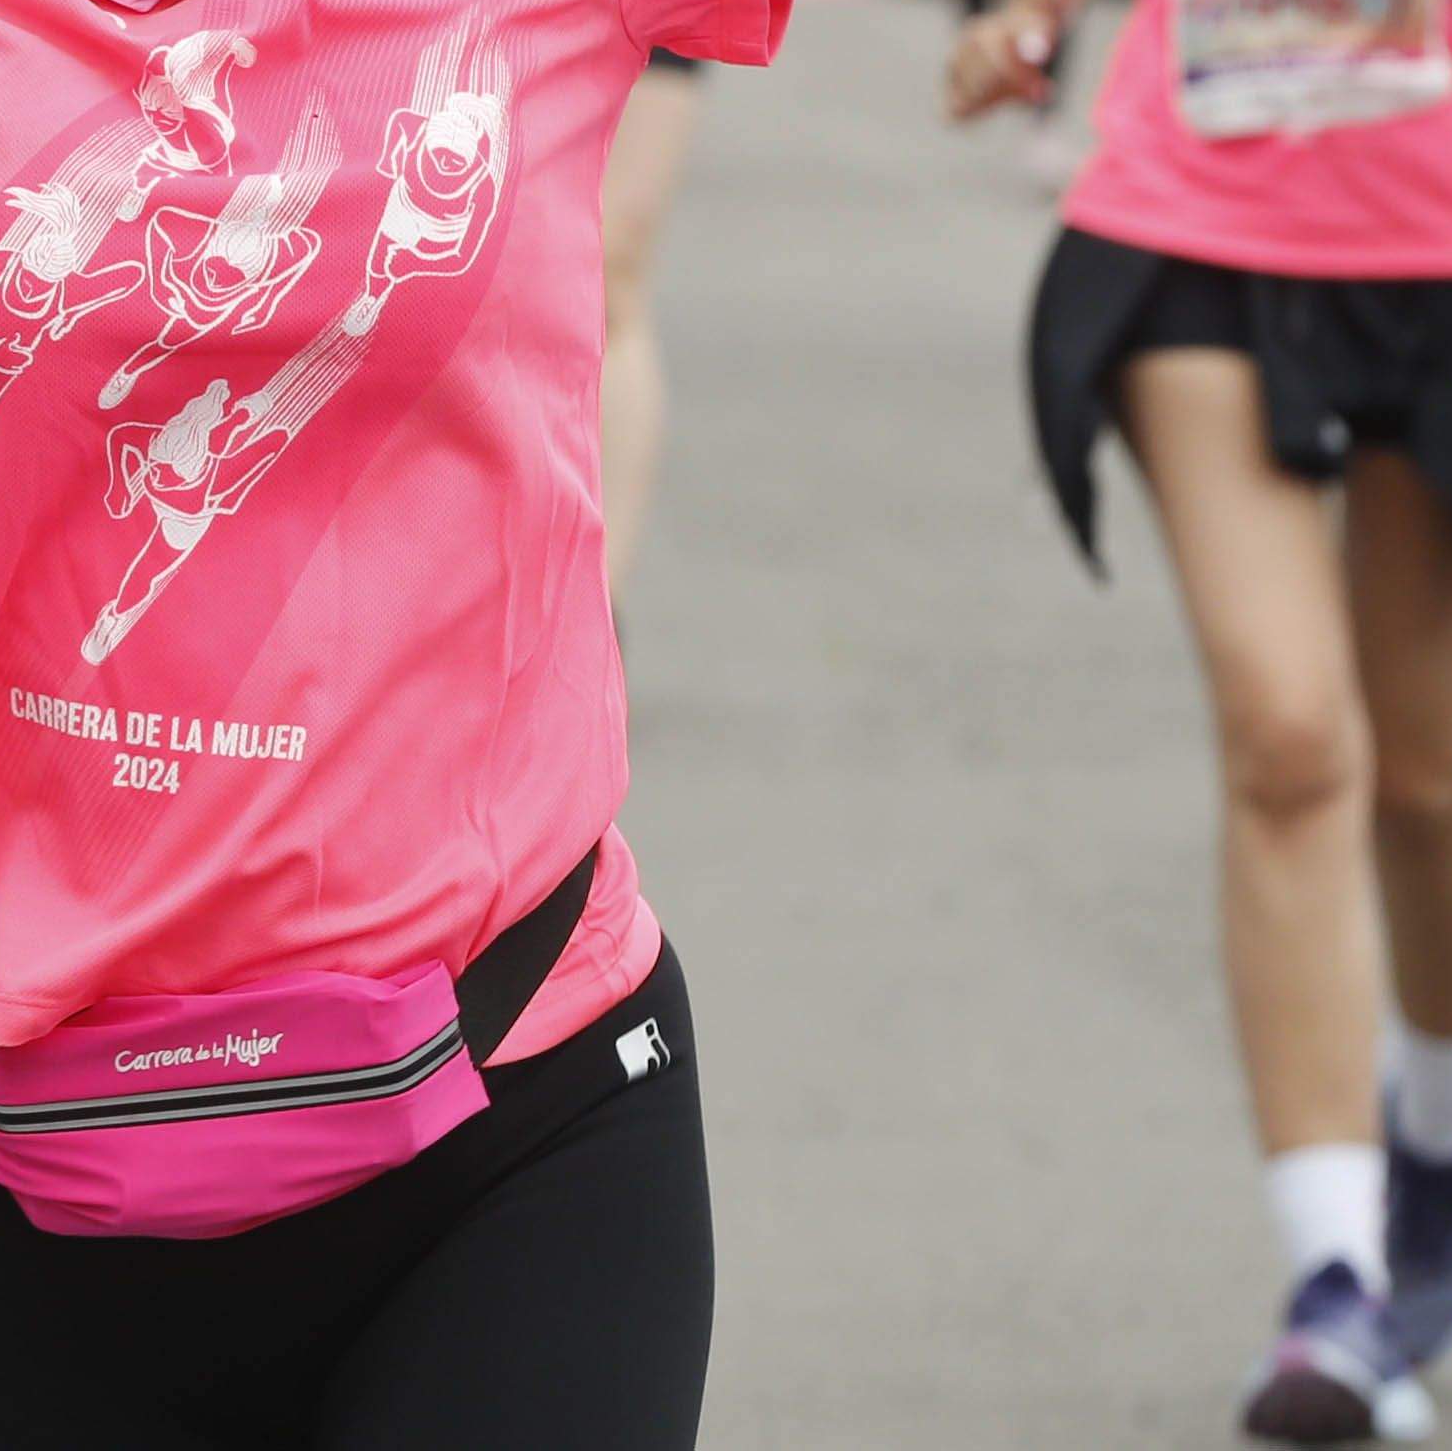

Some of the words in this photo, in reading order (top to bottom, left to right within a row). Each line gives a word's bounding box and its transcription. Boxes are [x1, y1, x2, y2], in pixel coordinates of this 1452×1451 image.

[10, 687, 118, 742] CARRERA
[125, 711, 163, 748] DE
[169, 716, 203, 754] LA
[211, 720, 307, 761] MUJER
[112, 752, 181, 794] 2024
[115, 1047, 194, 1072] Carrera
[195, 1044, 211, 1061] de
[212, 1042, 225, 1058] la
[224, 1028, 284, 1067] Mujer
